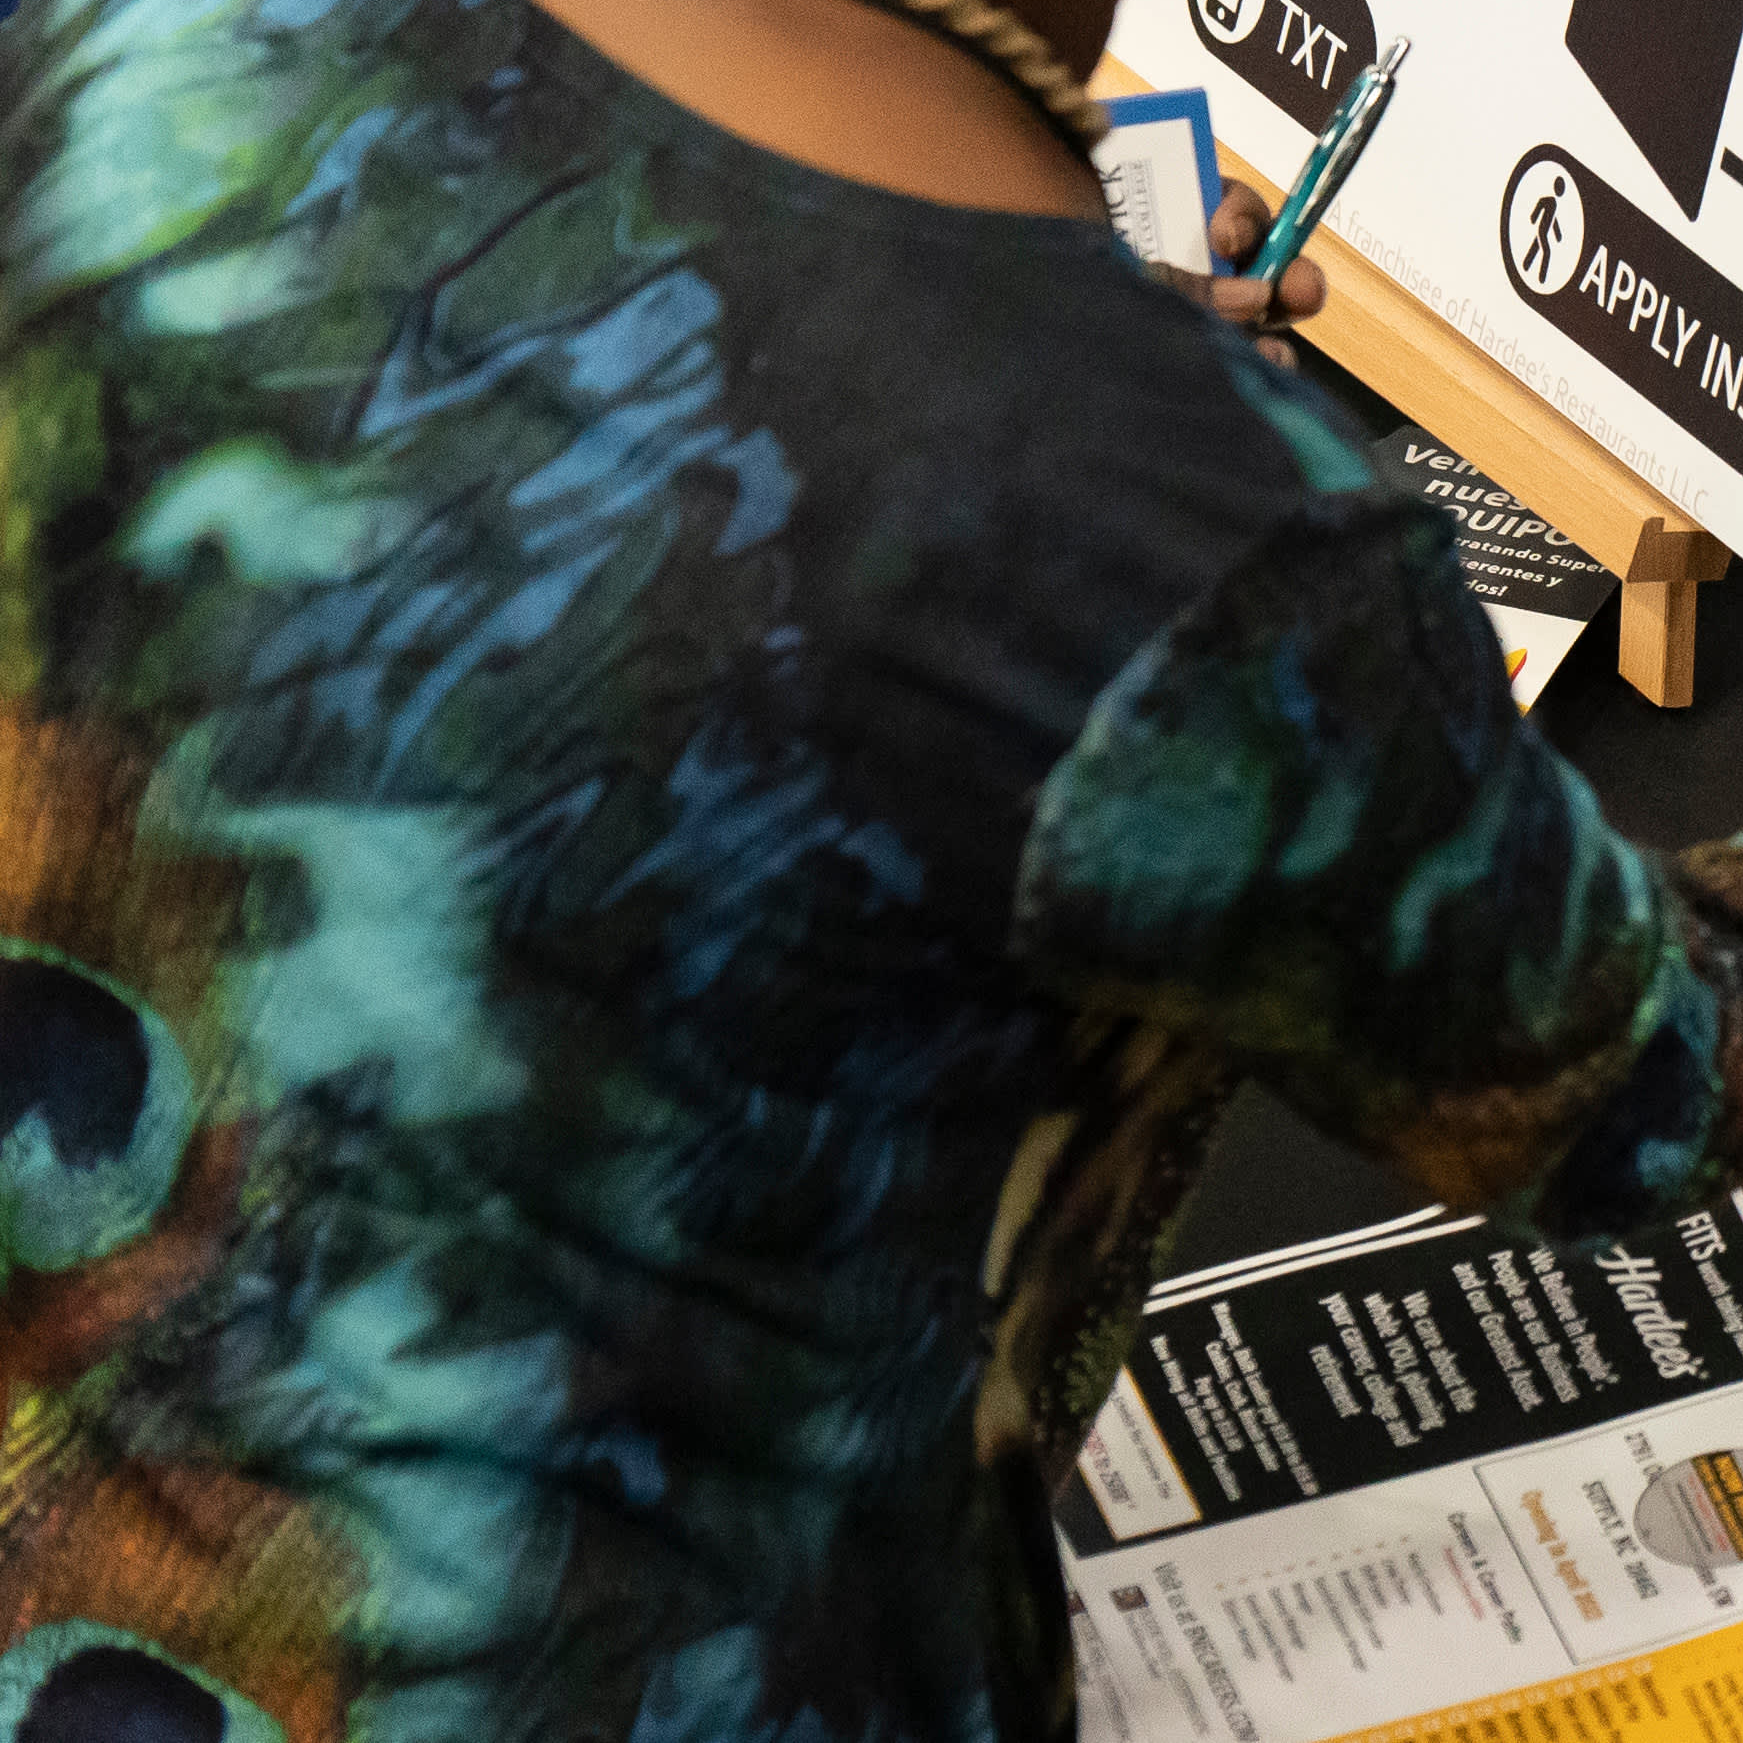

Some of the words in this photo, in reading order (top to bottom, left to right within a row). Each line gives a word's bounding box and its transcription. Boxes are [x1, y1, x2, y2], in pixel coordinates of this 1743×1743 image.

[1579, 244, 1700, 369] APPLY
[1347, 209, 1442, 307] franchisee
[1445, 298, 1471, 324] of
[1468, 309, 1553, 399] Hardee's
[1553, 376, 1666, 483] Restaurants
[1669, 474, 1709, 515] LLC
[1547, 576, 1563, 588] y
[1675, 1213, 1727, 1260] FITS
[1451, 1261, 1484, 1290] and
[1525, 1248, 1558, 1273] We
[1400, 1292, 1433, 1317] We
[1484, 1251, 1530, 1297] People
[1510, 1297, 1539, 1320] are
[1538, 1272, 1583, 1320] Believe
[1361, 1294, 1405, 1336] whole
[1412, 1318, 1447, 1347] care
[1599, 1249, 1705, 1376] Hardee's
[1307, 1346, 1364, 1416] retirement
[1319, 1294, 1354, 1325] your
[1386, 1419, 1420, 1446] and
[1428, 1348, 1469, 1387] about
[1448, 1386, 1482, 1411] the
